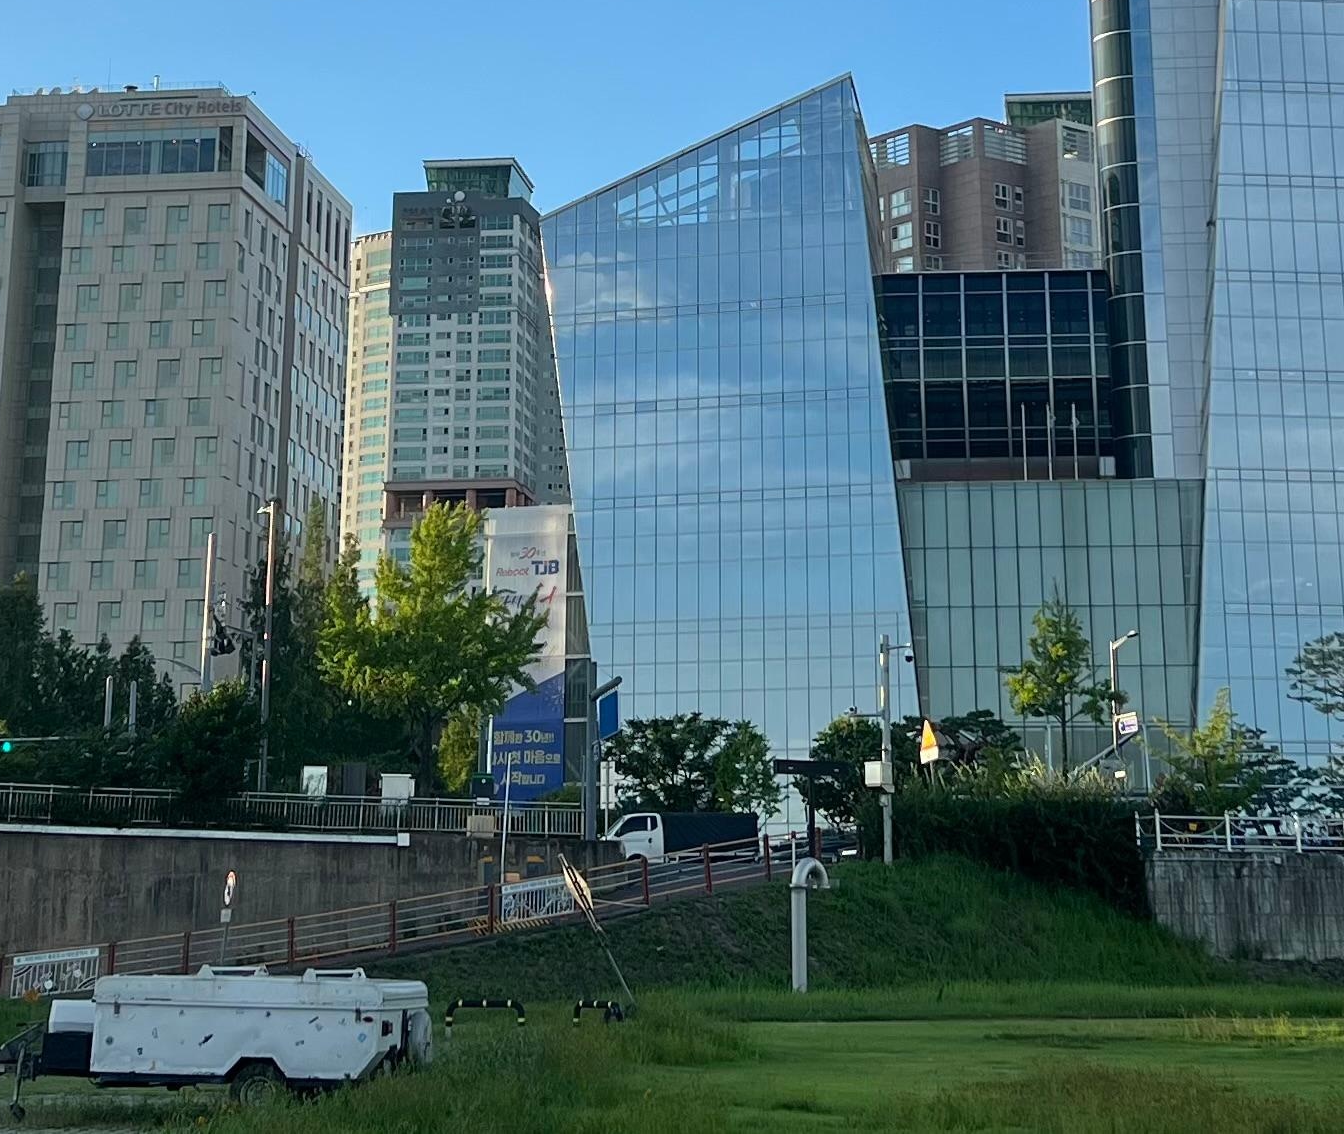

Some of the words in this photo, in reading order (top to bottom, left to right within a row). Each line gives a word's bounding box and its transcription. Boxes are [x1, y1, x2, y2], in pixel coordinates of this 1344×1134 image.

[97, 102, 161, 117] LOTTE
[165, 102, 193, 116] City
[531, 559, 560, 576] TJB
[524, 749, 561, 764] 마음으로
